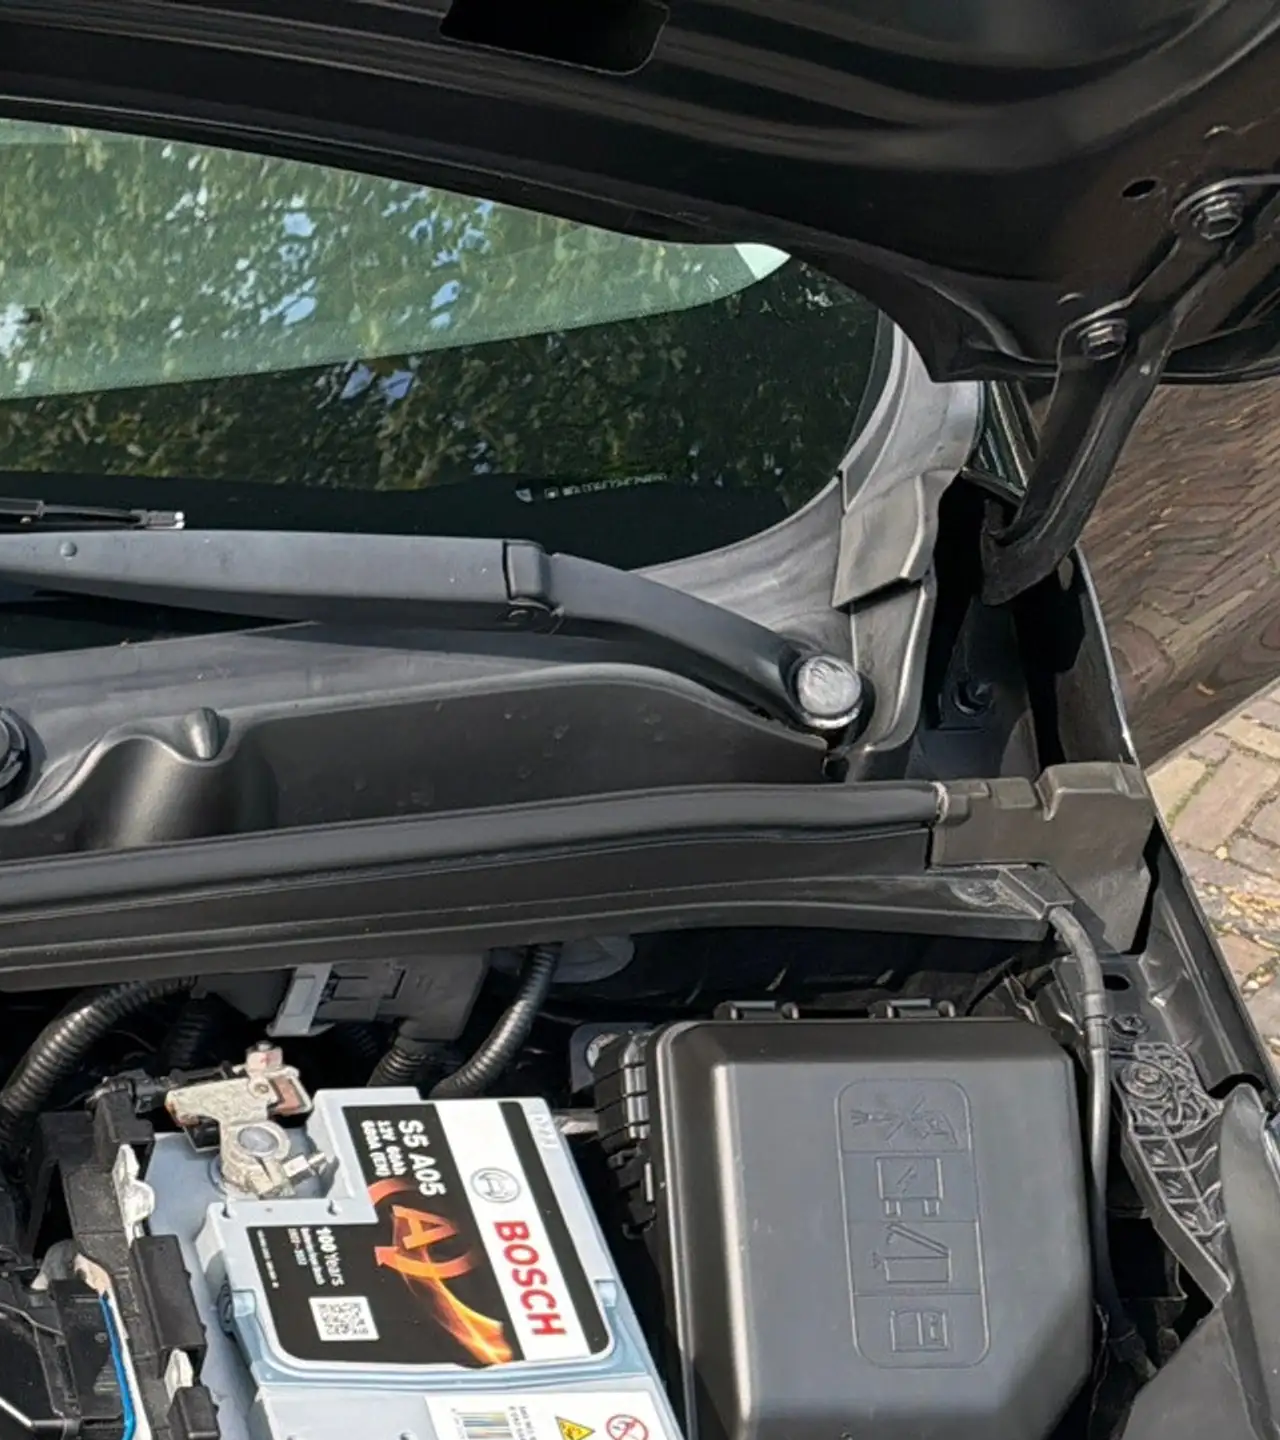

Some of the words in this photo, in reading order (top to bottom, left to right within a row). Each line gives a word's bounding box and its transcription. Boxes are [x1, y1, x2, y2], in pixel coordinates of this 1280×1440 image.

[398, 1119, 431, 1149] S5
[408, 1153, 448, 1197] A05
[315, 1226, 338, 1253] 100
[323, 1252, 345, 1287] Years
[493, 1220, 567, 1336] BOSCH
